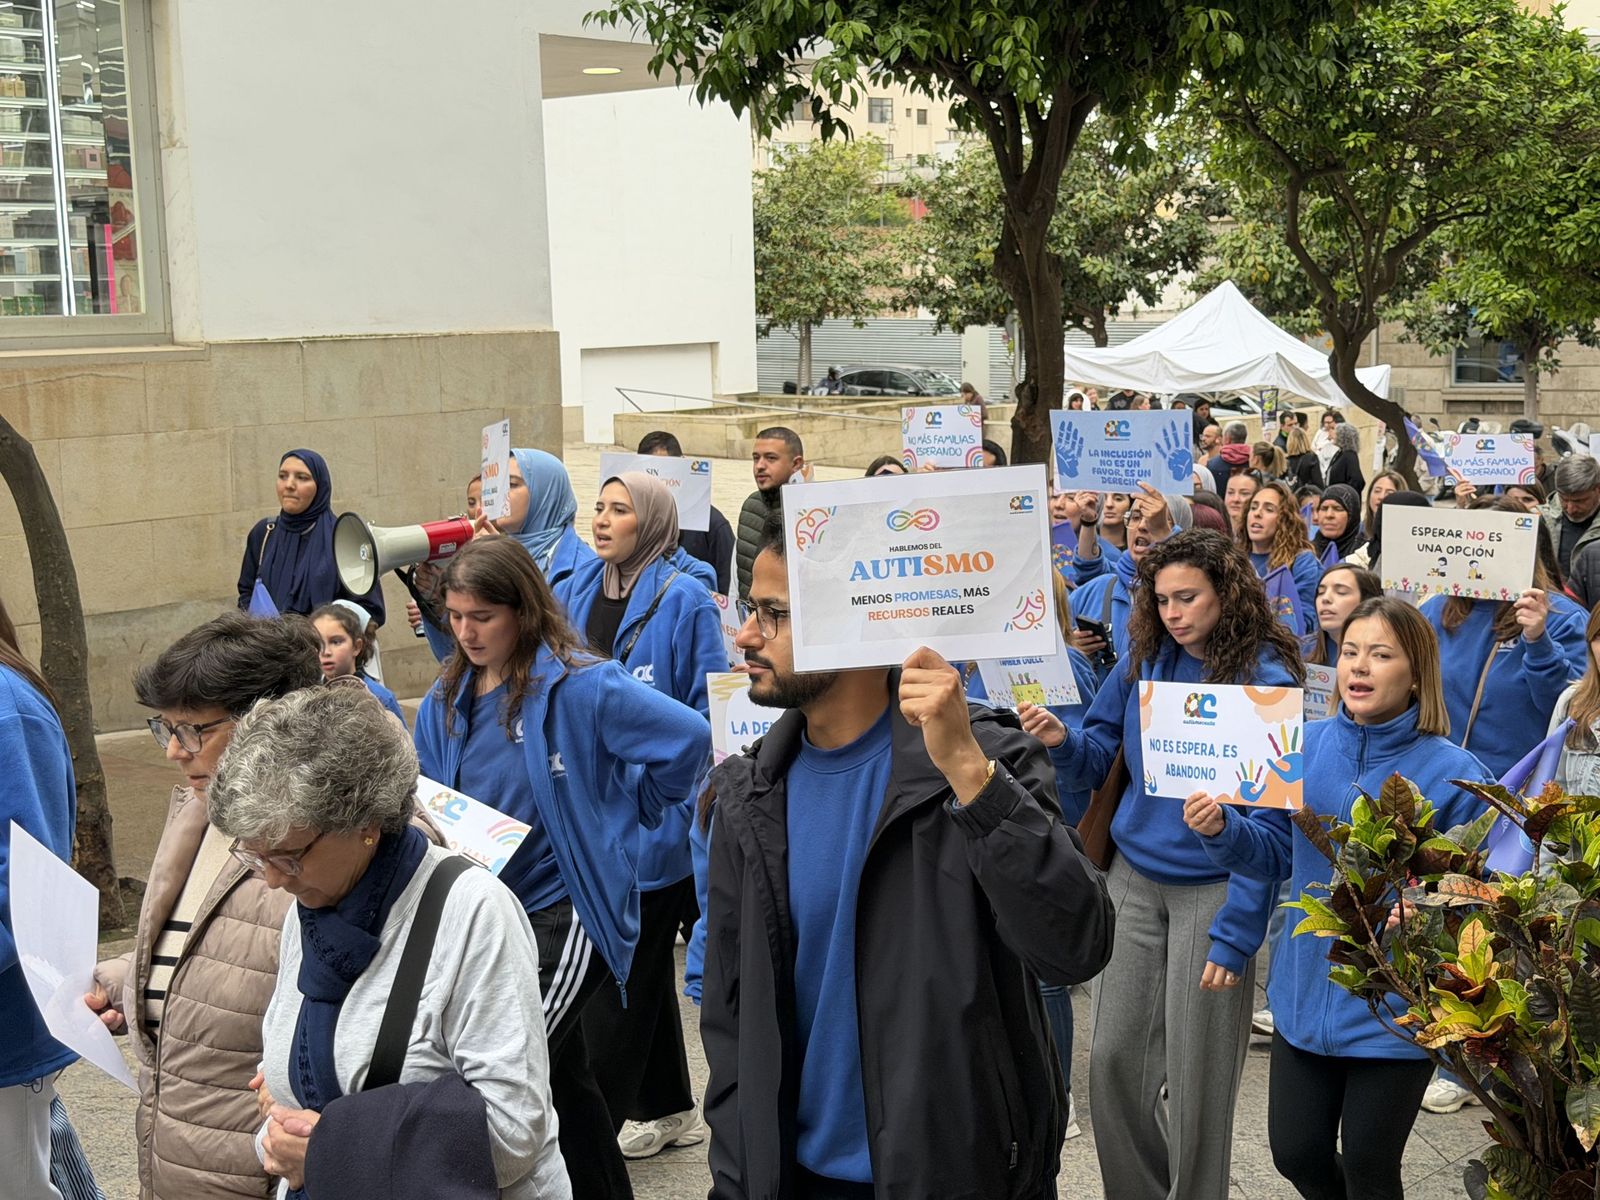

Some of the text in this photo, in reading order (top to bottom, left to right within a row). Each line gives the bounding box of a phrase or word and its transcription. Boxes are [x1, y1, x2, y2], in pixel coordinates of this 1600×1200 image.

[934, 435, 975, 445] FAMILIAS
[916, 447, 962, 457] ESPERANDO
[1101, 449, 1152, 458] INCLUSIÓN
[1100, 459, 1112, 467] NO
[1127, 460, 1140, 468] UN
[1465, 457, 1485, 466] MÁS
[1487, 457, 1528, 466] FAMILIAS
[1125, 469, 1135, 477] ES
[1137, 469, 1151, 477] UN
[1463, 467, 1515, 476] ESPERANDO
[1411, 526, 1503, 542] ESPERAR NO ES
[889, 542, 942, 552] HABLEMOS DEL
[1417, 543, 1494, 558] UNA OPCIÓN
[849, 551, 994, 581] AUTISMO
[851, 586, 990, 606] MENOS PROMESAS, MÁS
[868, 604, 975, 621] RECURSOS REALES
[731, 721, 749, 735] LA
[1150, 738, 1238, 758] NO ES ESPERA, ES
[1165, 763, 1217, 780] ABANDONO
